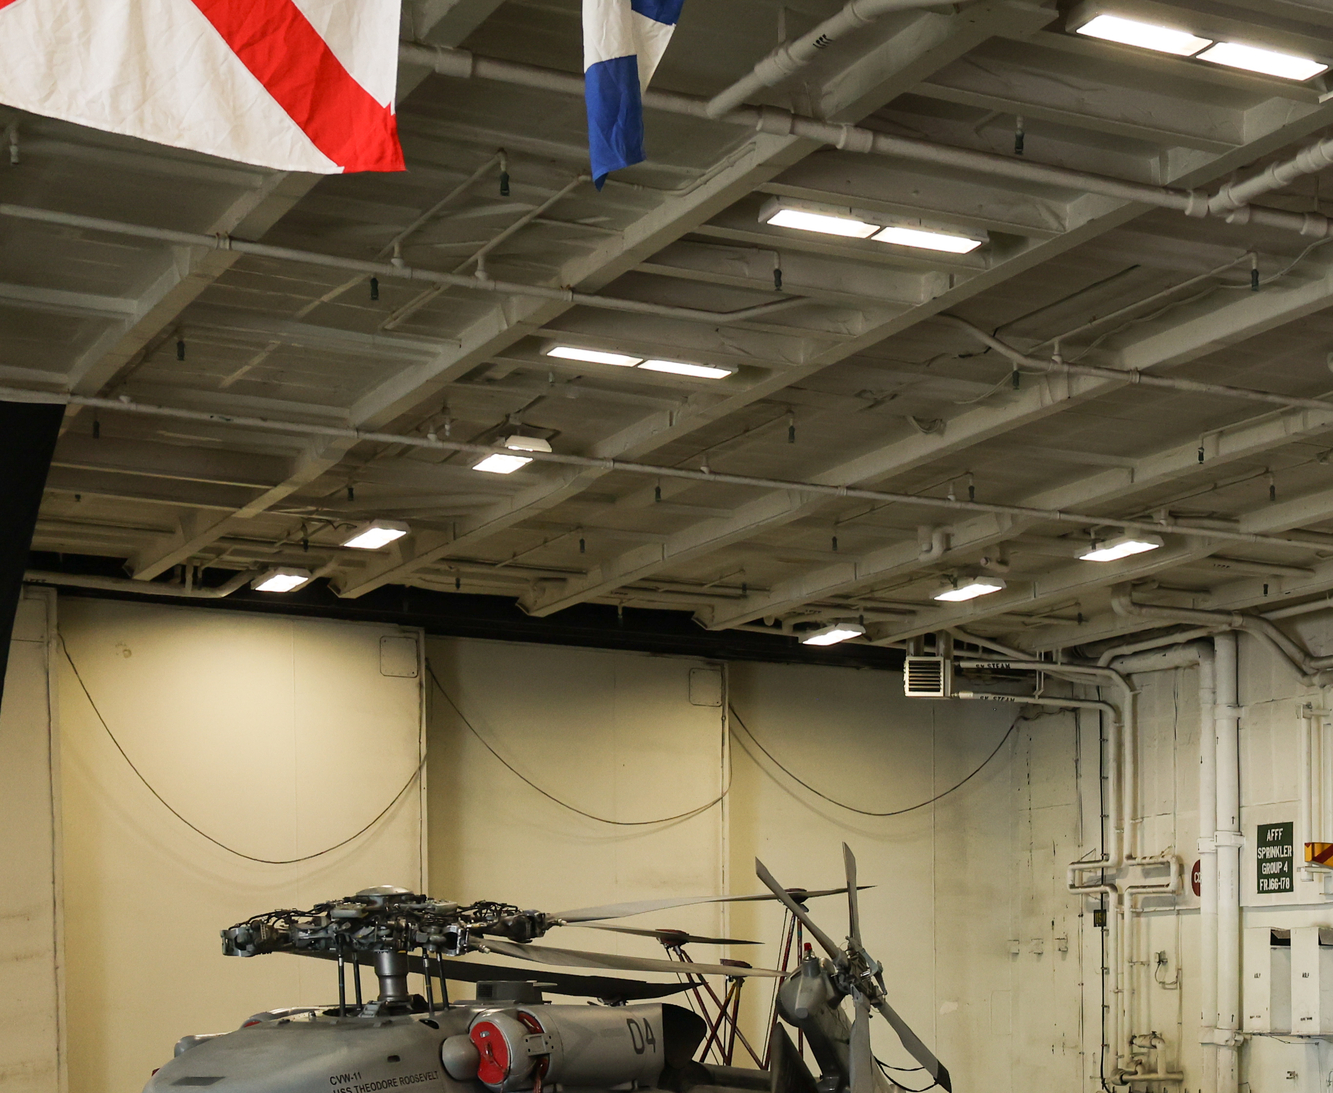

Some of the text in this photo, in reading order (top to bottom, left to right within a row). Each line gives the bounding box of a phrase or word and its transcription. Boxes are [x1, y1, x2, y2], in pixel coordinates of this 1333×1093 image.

[1266, 828, 1284, 842] AFFF
[1258, 845, 1292, 860] SPRINKLER
[1262, 861, 1288, 874] GROUP 4
[330, 1072, 362, 1086] CVW-11
[354, 1078, 398, 1093] THEODORE
[399, 1071, 440, 1086] ROOSEVELT
